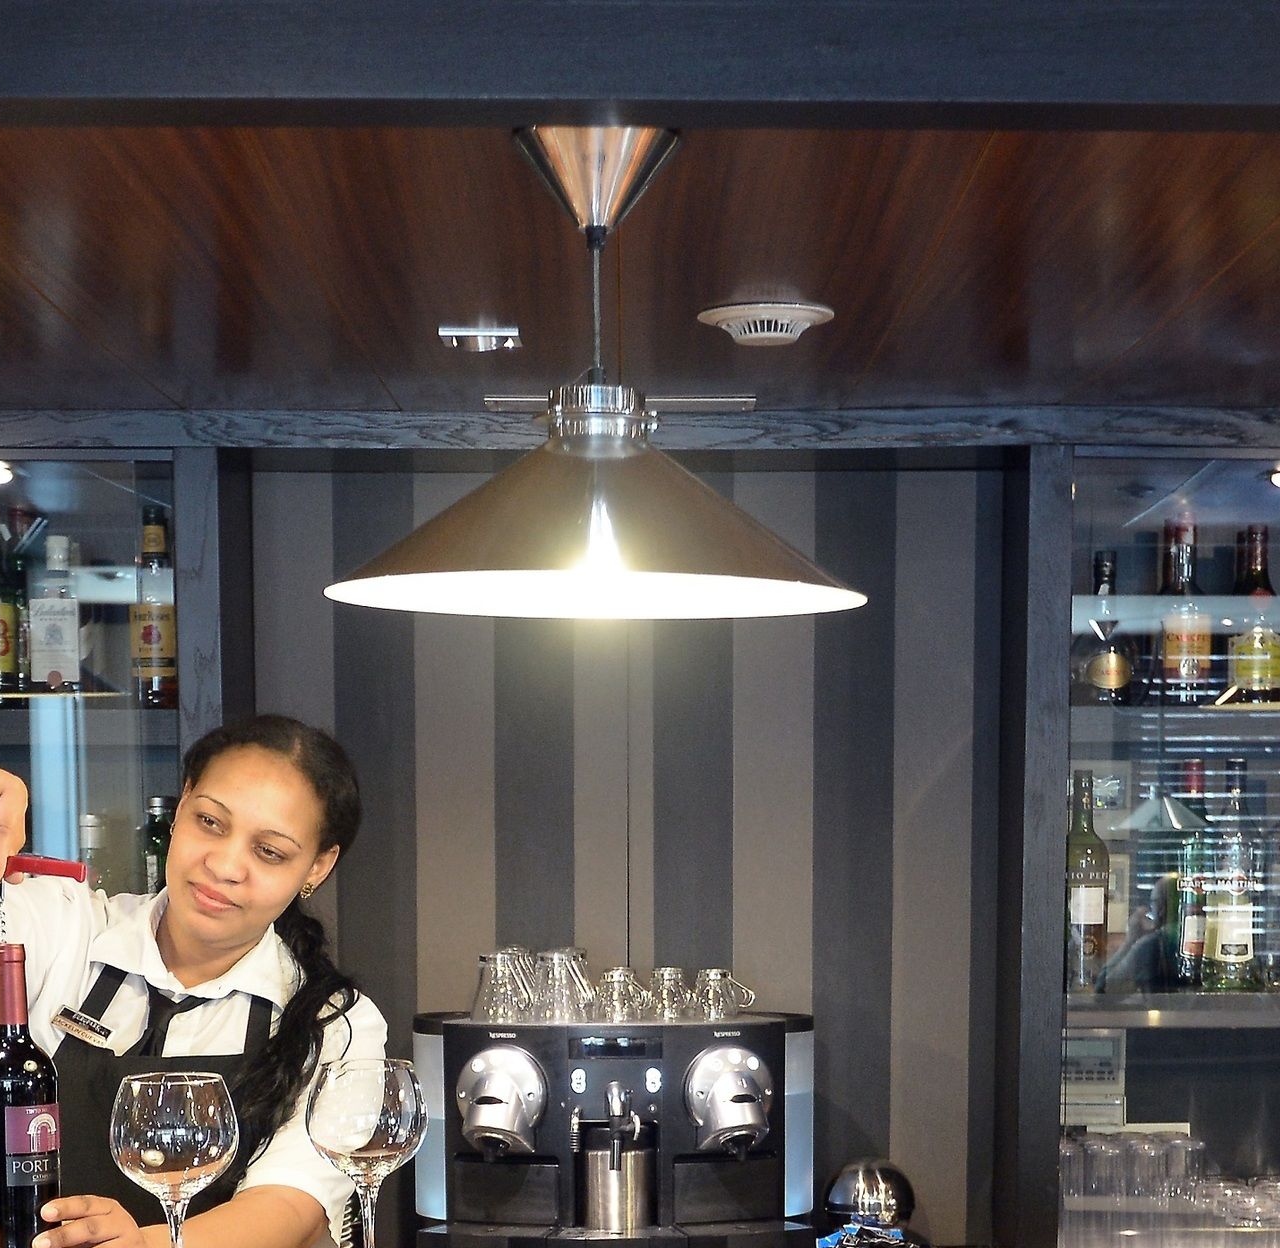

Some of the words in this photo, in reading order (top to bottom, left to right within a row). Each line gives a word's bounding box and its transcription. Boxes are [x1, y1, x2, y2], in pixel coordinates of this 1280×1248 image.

[1180, 879, 1205, 888] MART
[489, 1031, 517, 1039] NESPRESSO
[713, 1030, 741, 1038] NESPRESSO
[12, 1159, 51, 1174] PORT
